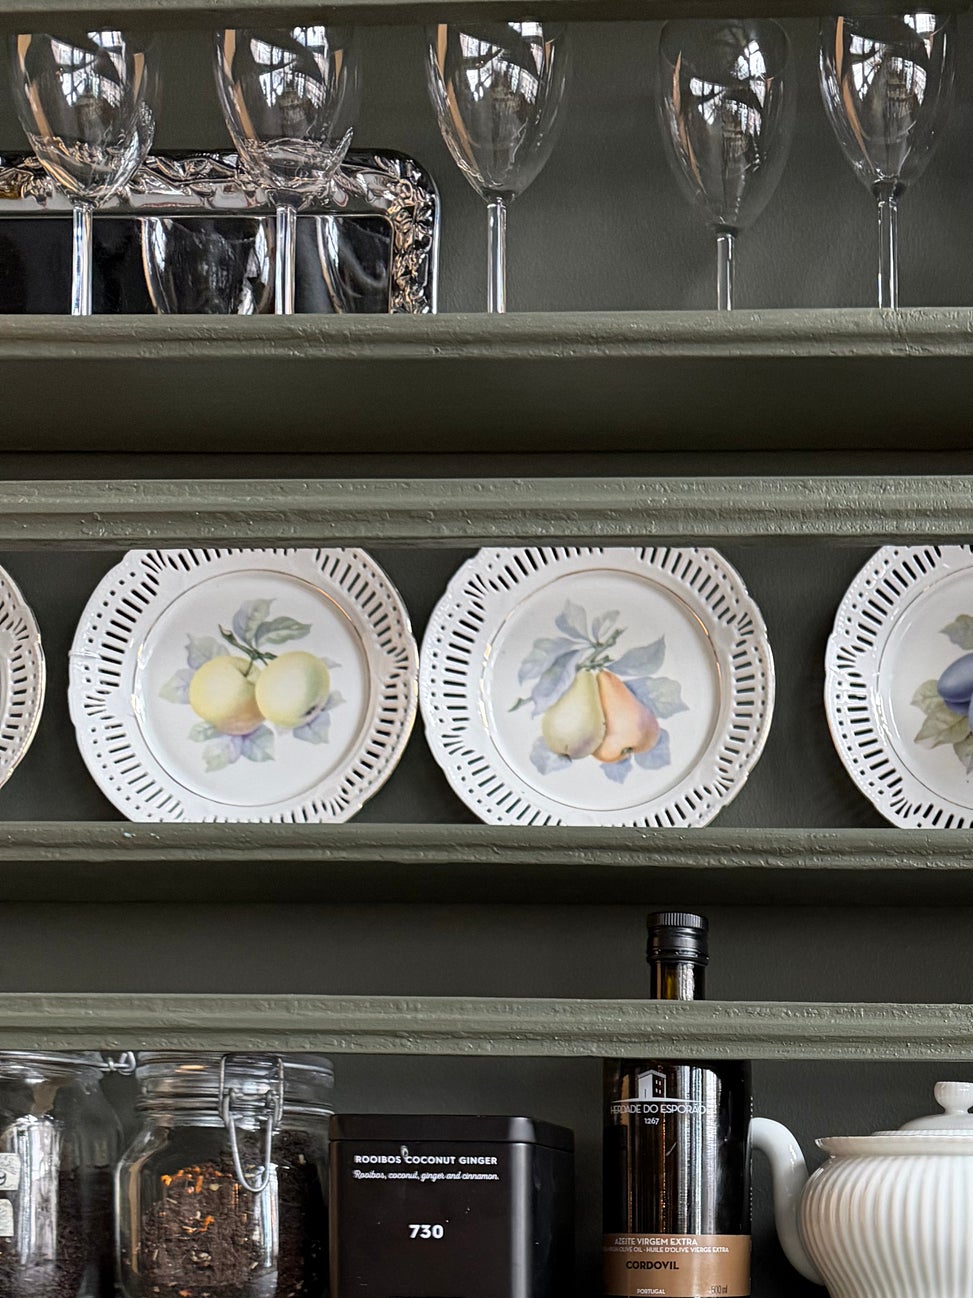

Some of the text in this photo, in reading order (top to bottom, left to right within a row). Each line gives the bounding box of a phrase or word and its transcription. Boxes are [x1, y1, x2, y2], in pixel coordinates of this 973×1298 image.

[643, 1104, 659, 1114] DO
[660, 1103, 706, 1115] ESPORÃO
[644, 1117, 660, 1125] 1267
[354, 1155, 498, 1165] ROOIBOS COCONUT GINGER
[352, 1169, 499, 1182] Rooibos, coconut, ginger and cinnamon.
[408, 1224, 444, 1239] 730
[615, 1237, 698, 1246] AZEITE VIRGEM EXTRA
[626, 1260, 679, 1270] CORDOVIL
